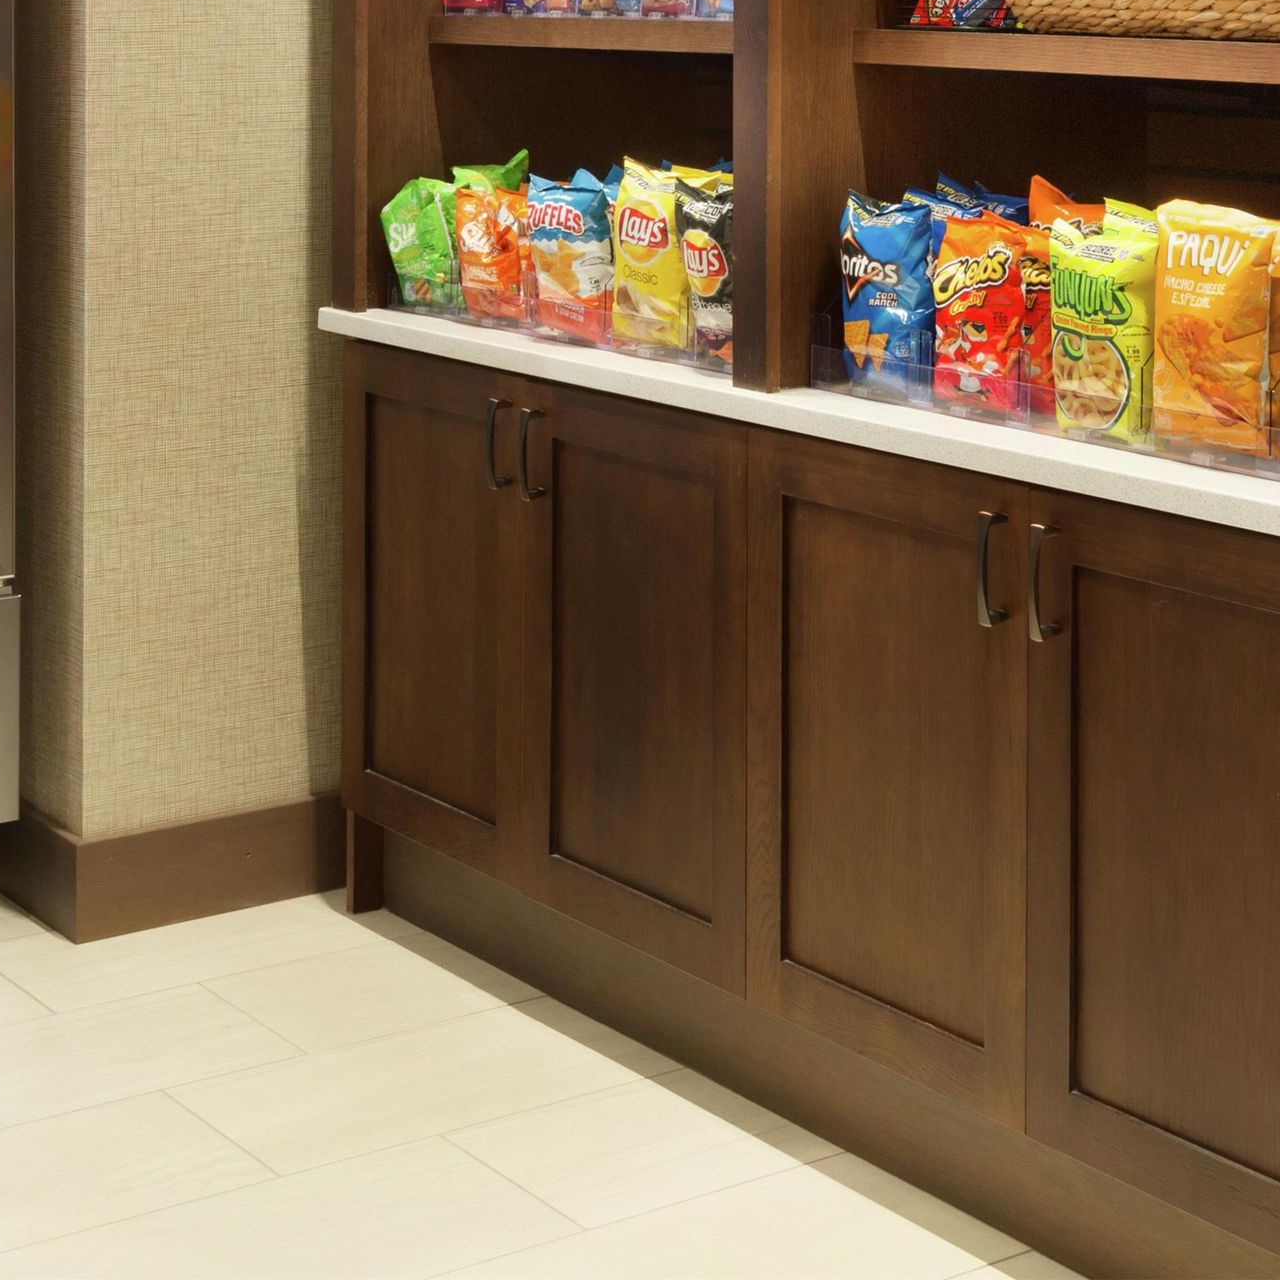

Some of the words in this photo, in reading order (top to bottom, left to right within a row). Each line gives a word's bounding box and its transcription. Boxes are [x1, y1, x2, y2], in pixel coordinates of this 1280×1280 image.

[528, 201, 584, 235] RUFFLES
[621, 207, 666, 247] Lay's
[1167, 230, 1250, 277] PAQUI
[623, 264, 658, 286] Classic
[1163, 275, 1195, 292] NACHO
[1197, 278, 1227, 296] CHEESE
[869, 298, 899, 308] RANCH
[876, 291, 898, 300] COOL
[1171, 293, 1213, 310] ESPECIAL
